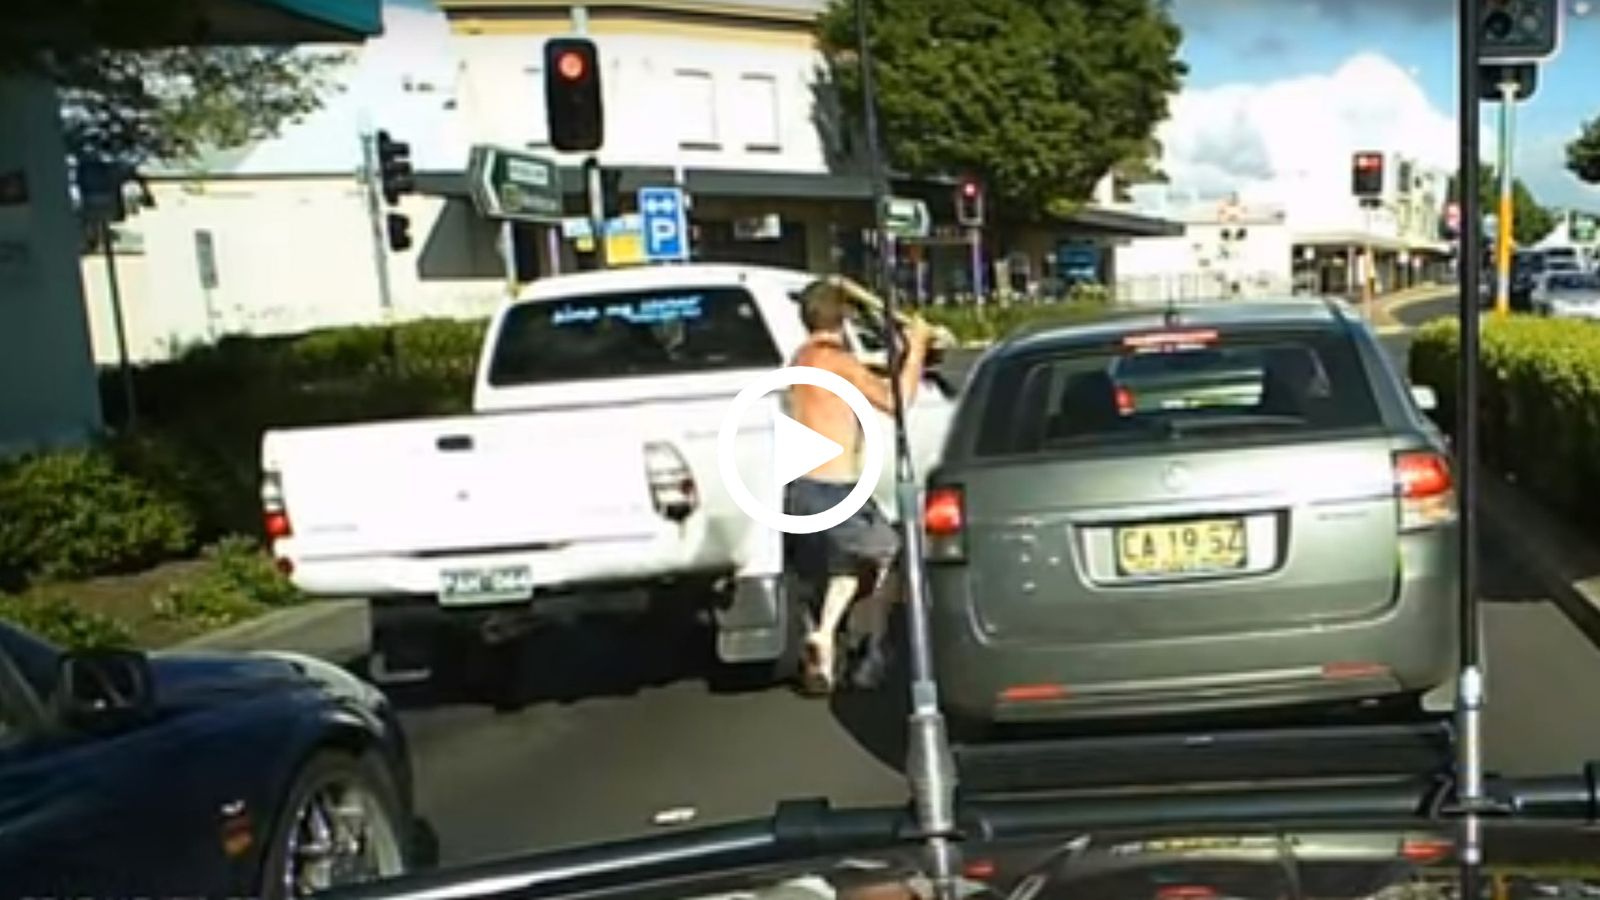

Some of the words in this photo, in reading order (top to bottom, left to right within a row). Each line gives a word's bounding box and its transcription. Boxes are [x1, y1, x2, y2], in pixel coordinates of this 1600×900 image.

[651, 218, 676, 253] P
[1123, 531, 1157, 560] CA
[1167, 527, 1198, 555] 19
